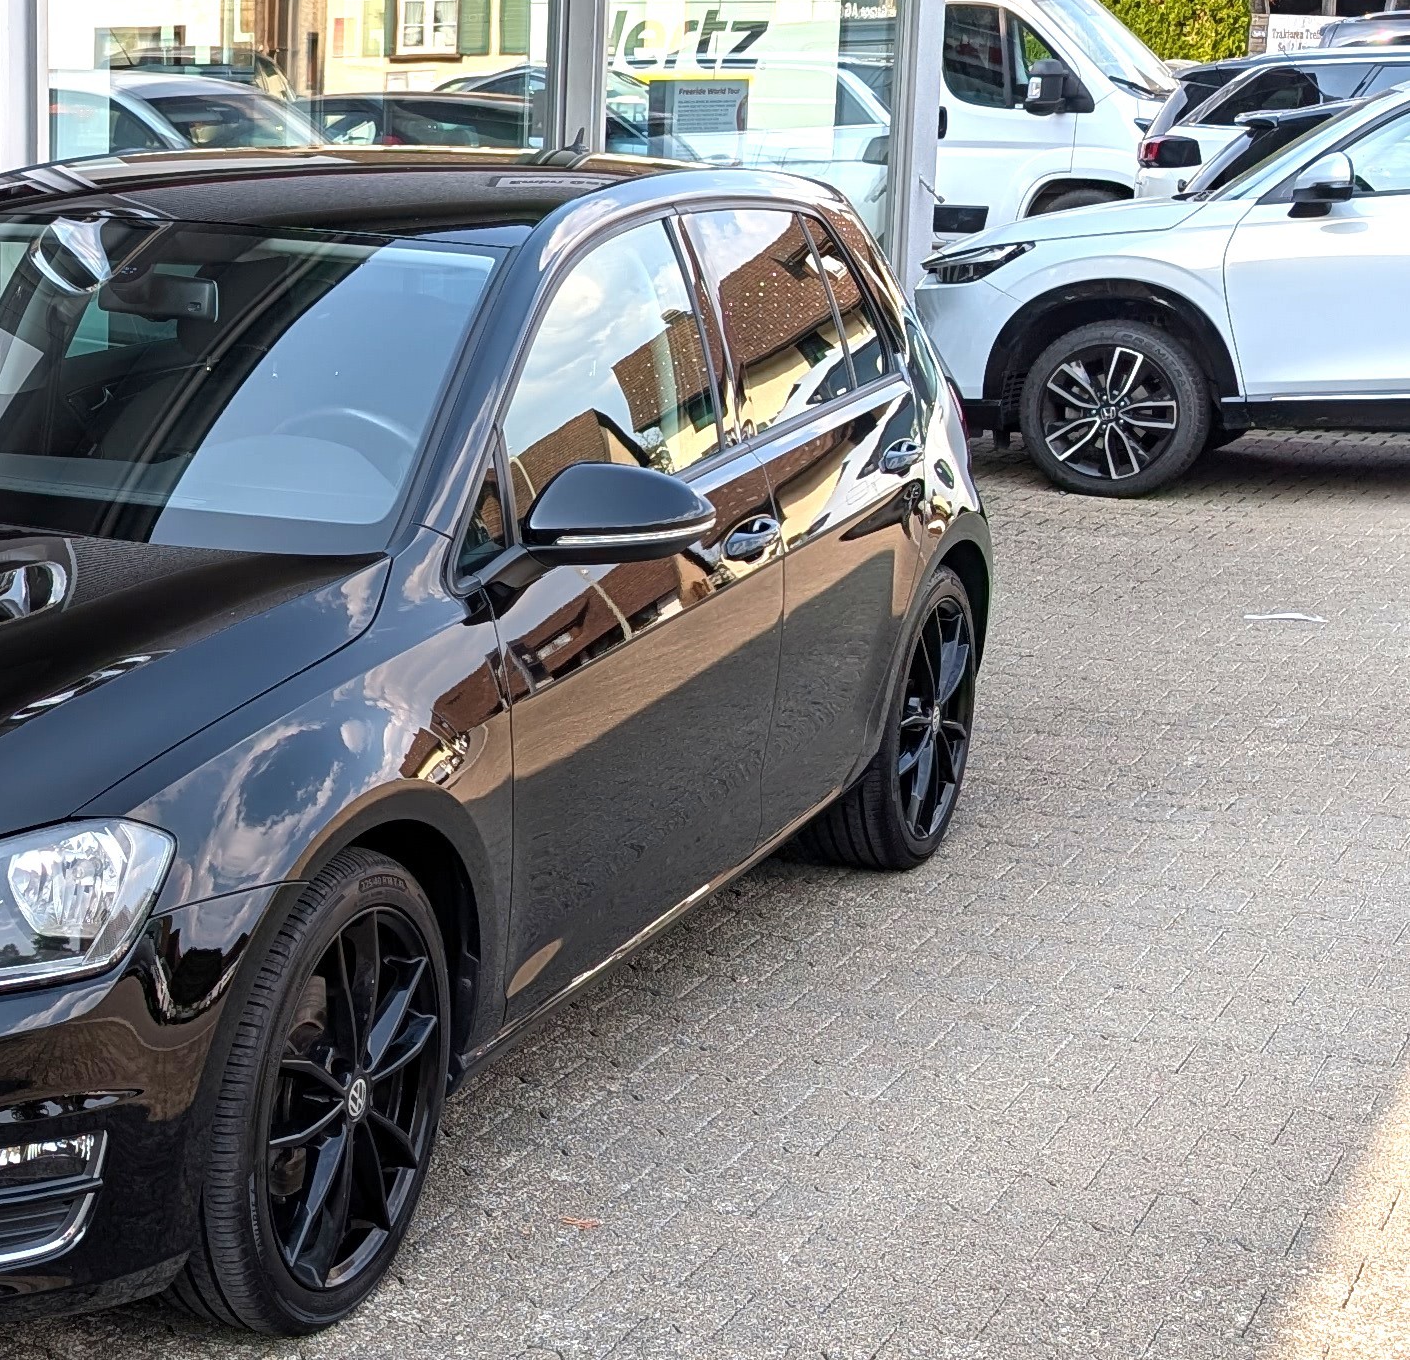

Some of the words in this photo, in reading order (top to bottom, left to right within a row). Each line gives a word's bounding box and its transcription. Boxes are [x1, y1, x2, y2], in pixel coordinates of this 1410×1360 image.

[678, 87, 706, 95] Freeride
[707, 87, 726, 95] World
[727, 87, 741, 95] Tour
